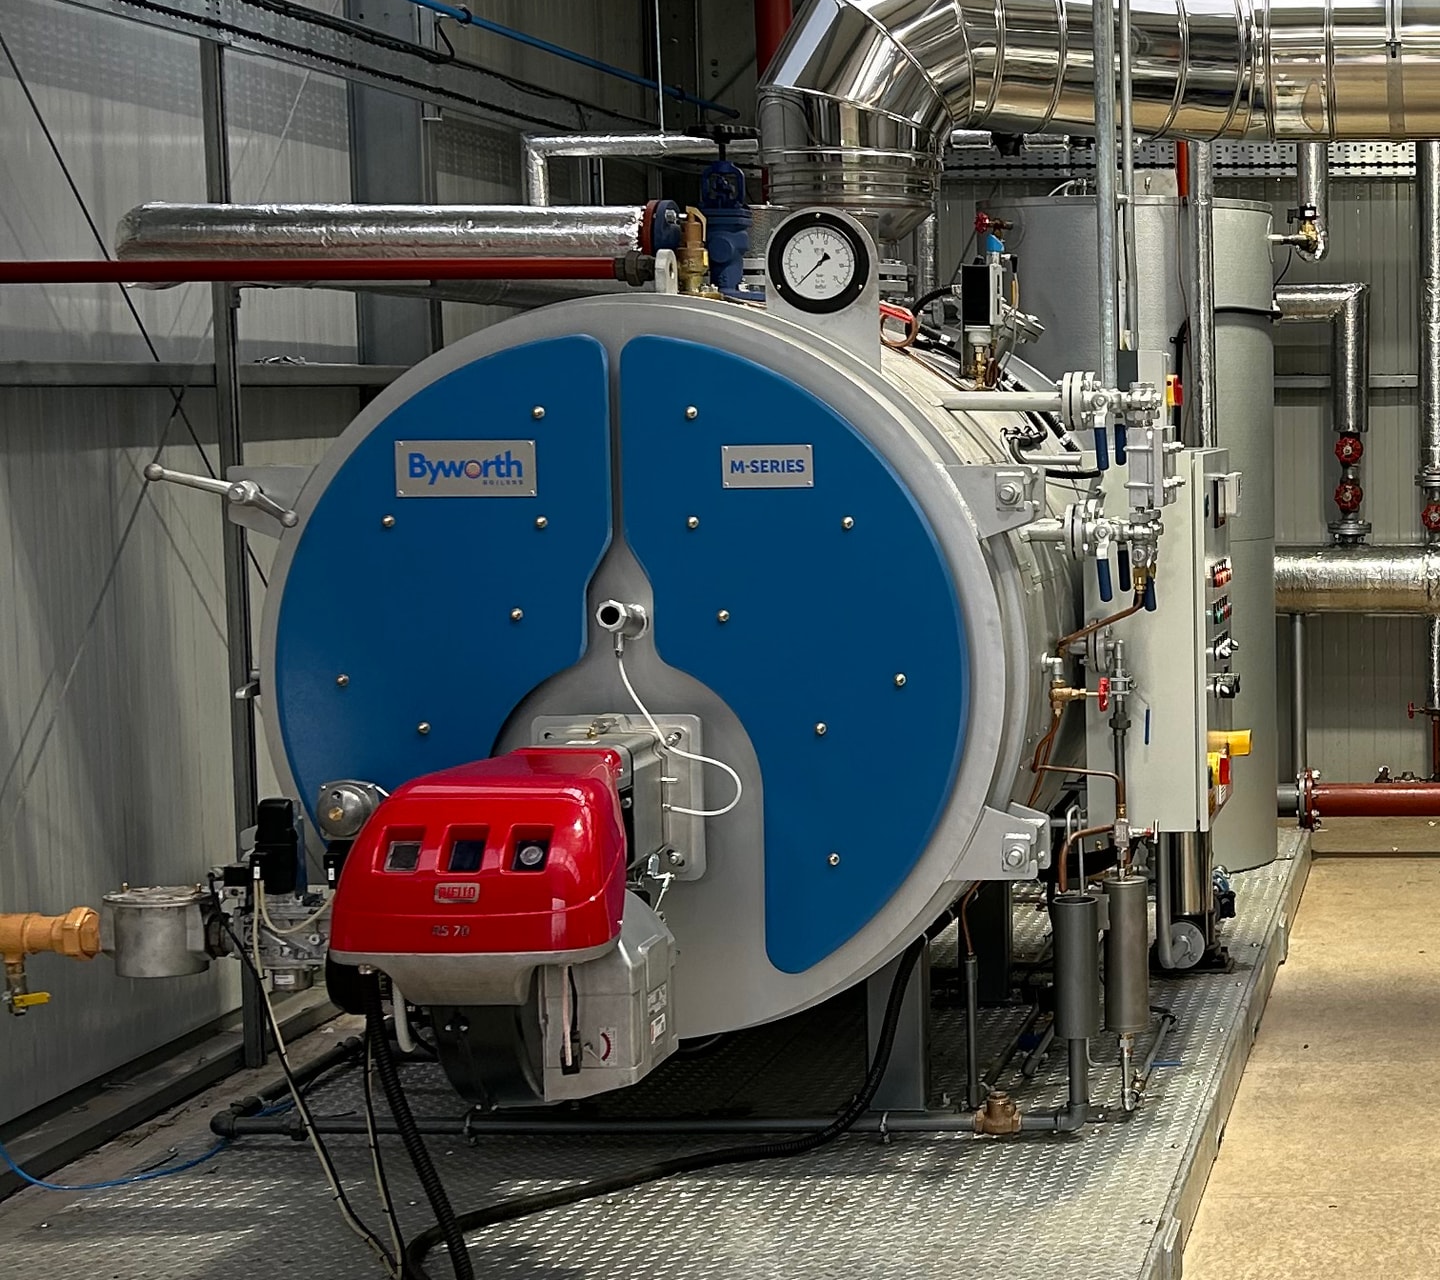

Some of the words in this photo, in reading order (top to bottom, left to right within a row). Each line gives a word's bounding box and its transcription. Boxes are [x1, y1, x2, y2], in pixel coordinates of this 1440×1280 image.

[408, 450, 523, 485] Byworth
[730, 459, 805, 473] M-SERIES
[453, 925, 470, 936] 70
